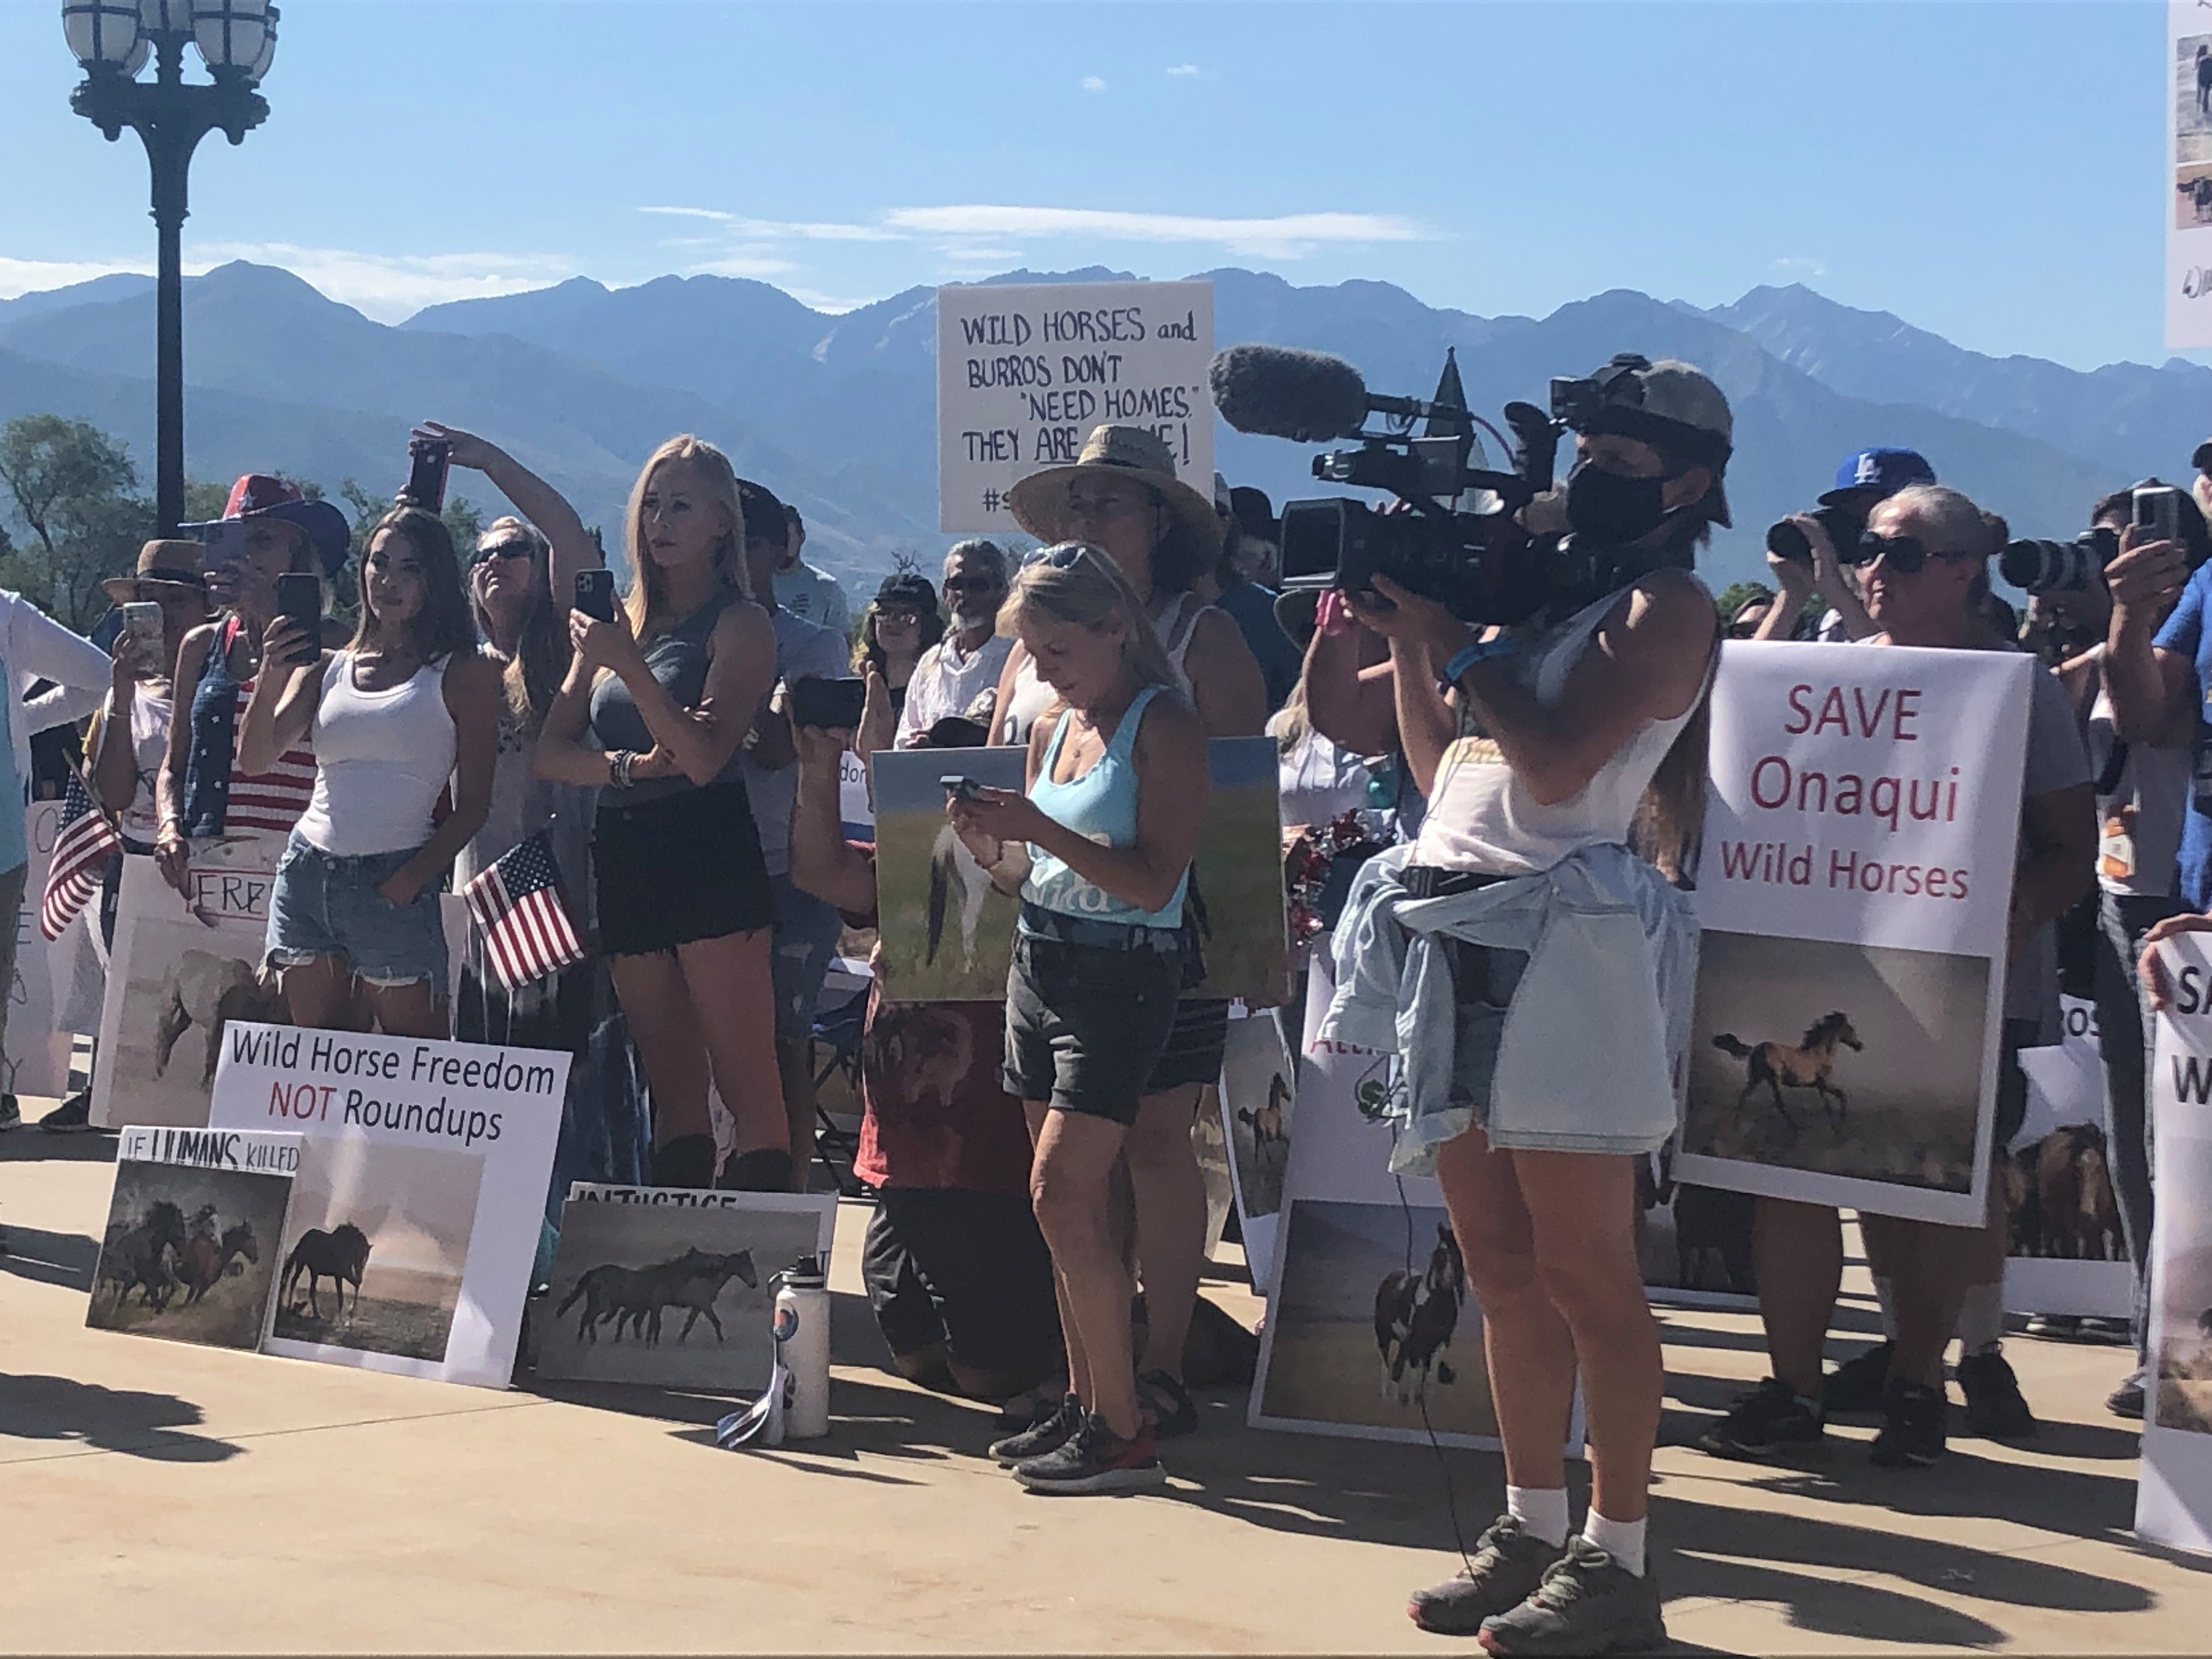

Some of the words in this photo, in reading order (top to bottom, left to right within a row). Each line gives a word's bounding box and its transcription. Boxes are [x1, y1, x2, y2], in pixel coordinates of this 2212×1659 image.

[961, 313, 1031, 346] WILD
[1043, 307, 1146, 343] HORSES
[1157, 310, 1197, 341] and
[967, 354, 1052, 388] BURROS
[1062, 351, 1122, 384] DON'T
[962, 428, 1019, 461] THEY
[1034, 426, 1079, 461] ARE
[1784, 684, 1922, 741] SAVE
[1751, 755, 1959, 832] Onaqui
[1721, 840, 1813, 885] Wild
[1829, 849, 1970, 899] Horses
[2176, 966, 2212, 1014] S
[233, 1029, 301, 1069] Wild
[311, 1036, 399, 1079] Horse
[411, 1046, 555, 1095] Freedom
[268, 1081, 337, 1121] NOT
[344, 1089, 503, 1147] Roundups
